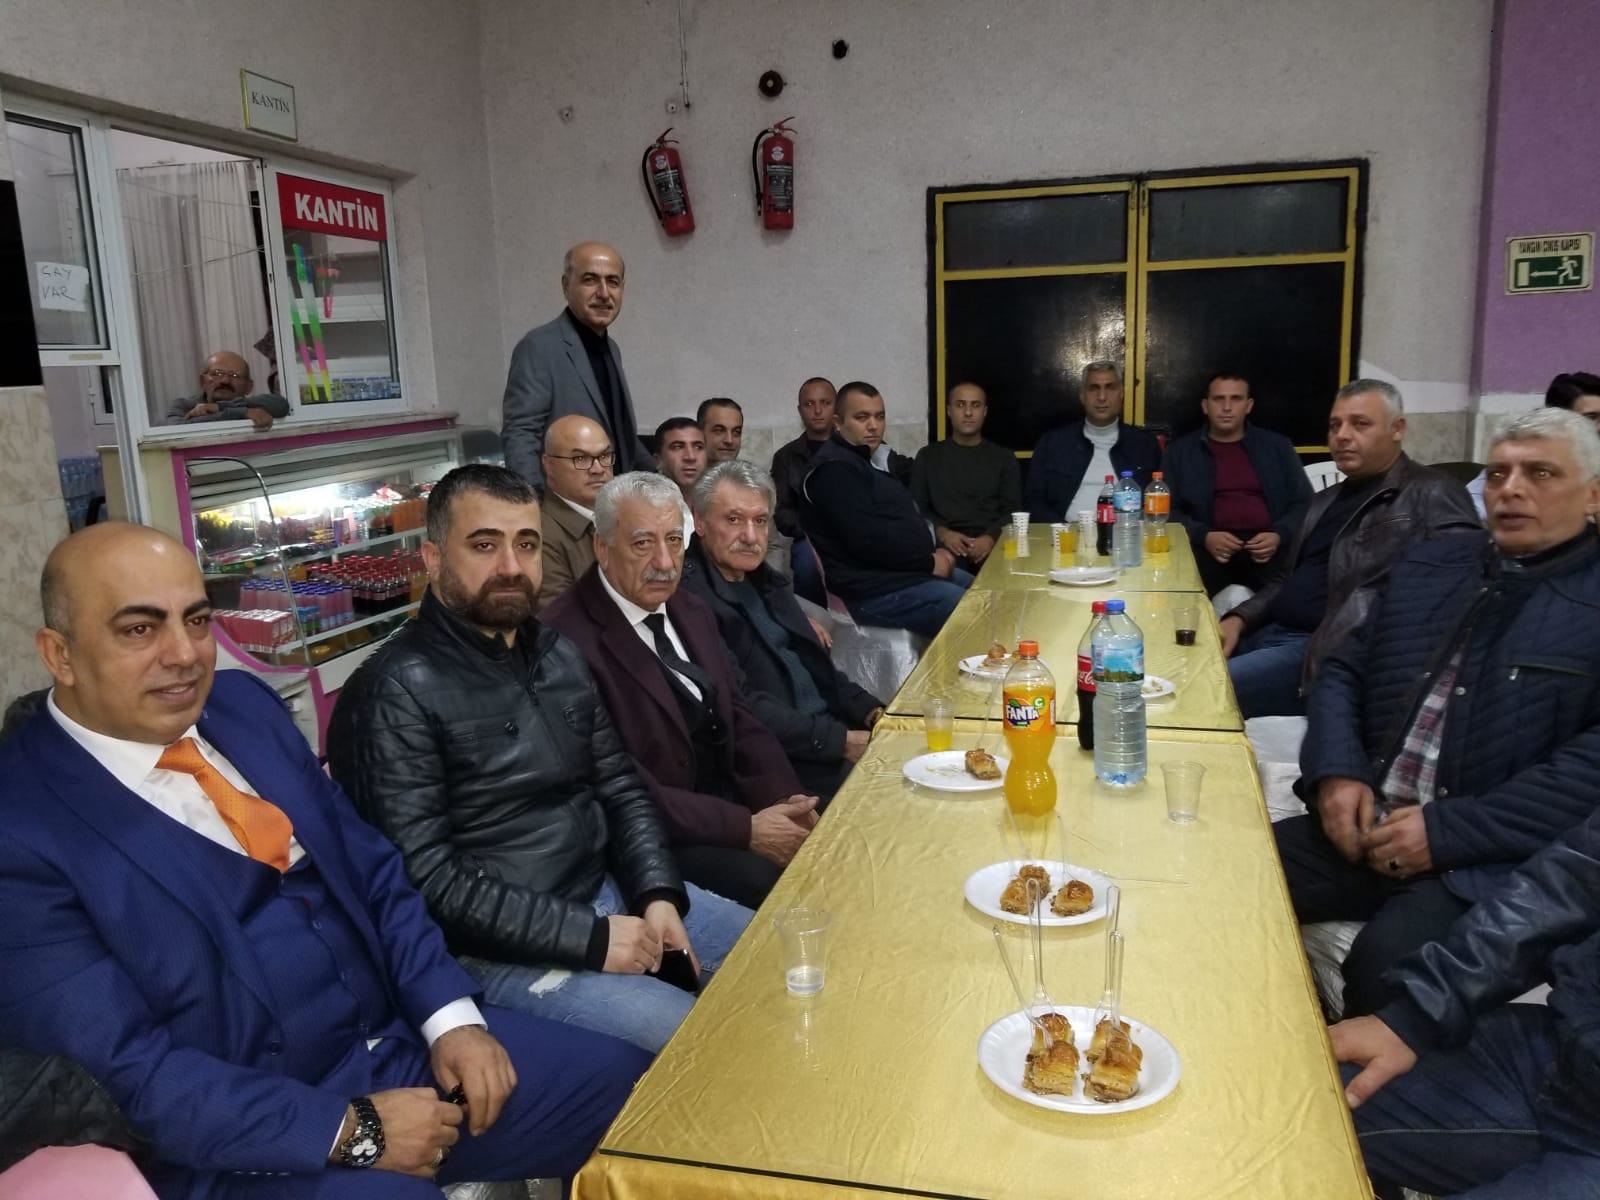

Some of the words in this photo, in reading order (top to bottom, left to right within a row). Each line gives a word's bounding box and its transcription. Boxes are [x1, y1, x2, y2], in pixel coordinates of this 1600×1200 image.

[251, 91, 290, 113] KANTİN
[294, 192, 379, 232] KANTİN
[42, 285, 76, 301] VAR
[1006, 704, 1040, 721] FANTA
